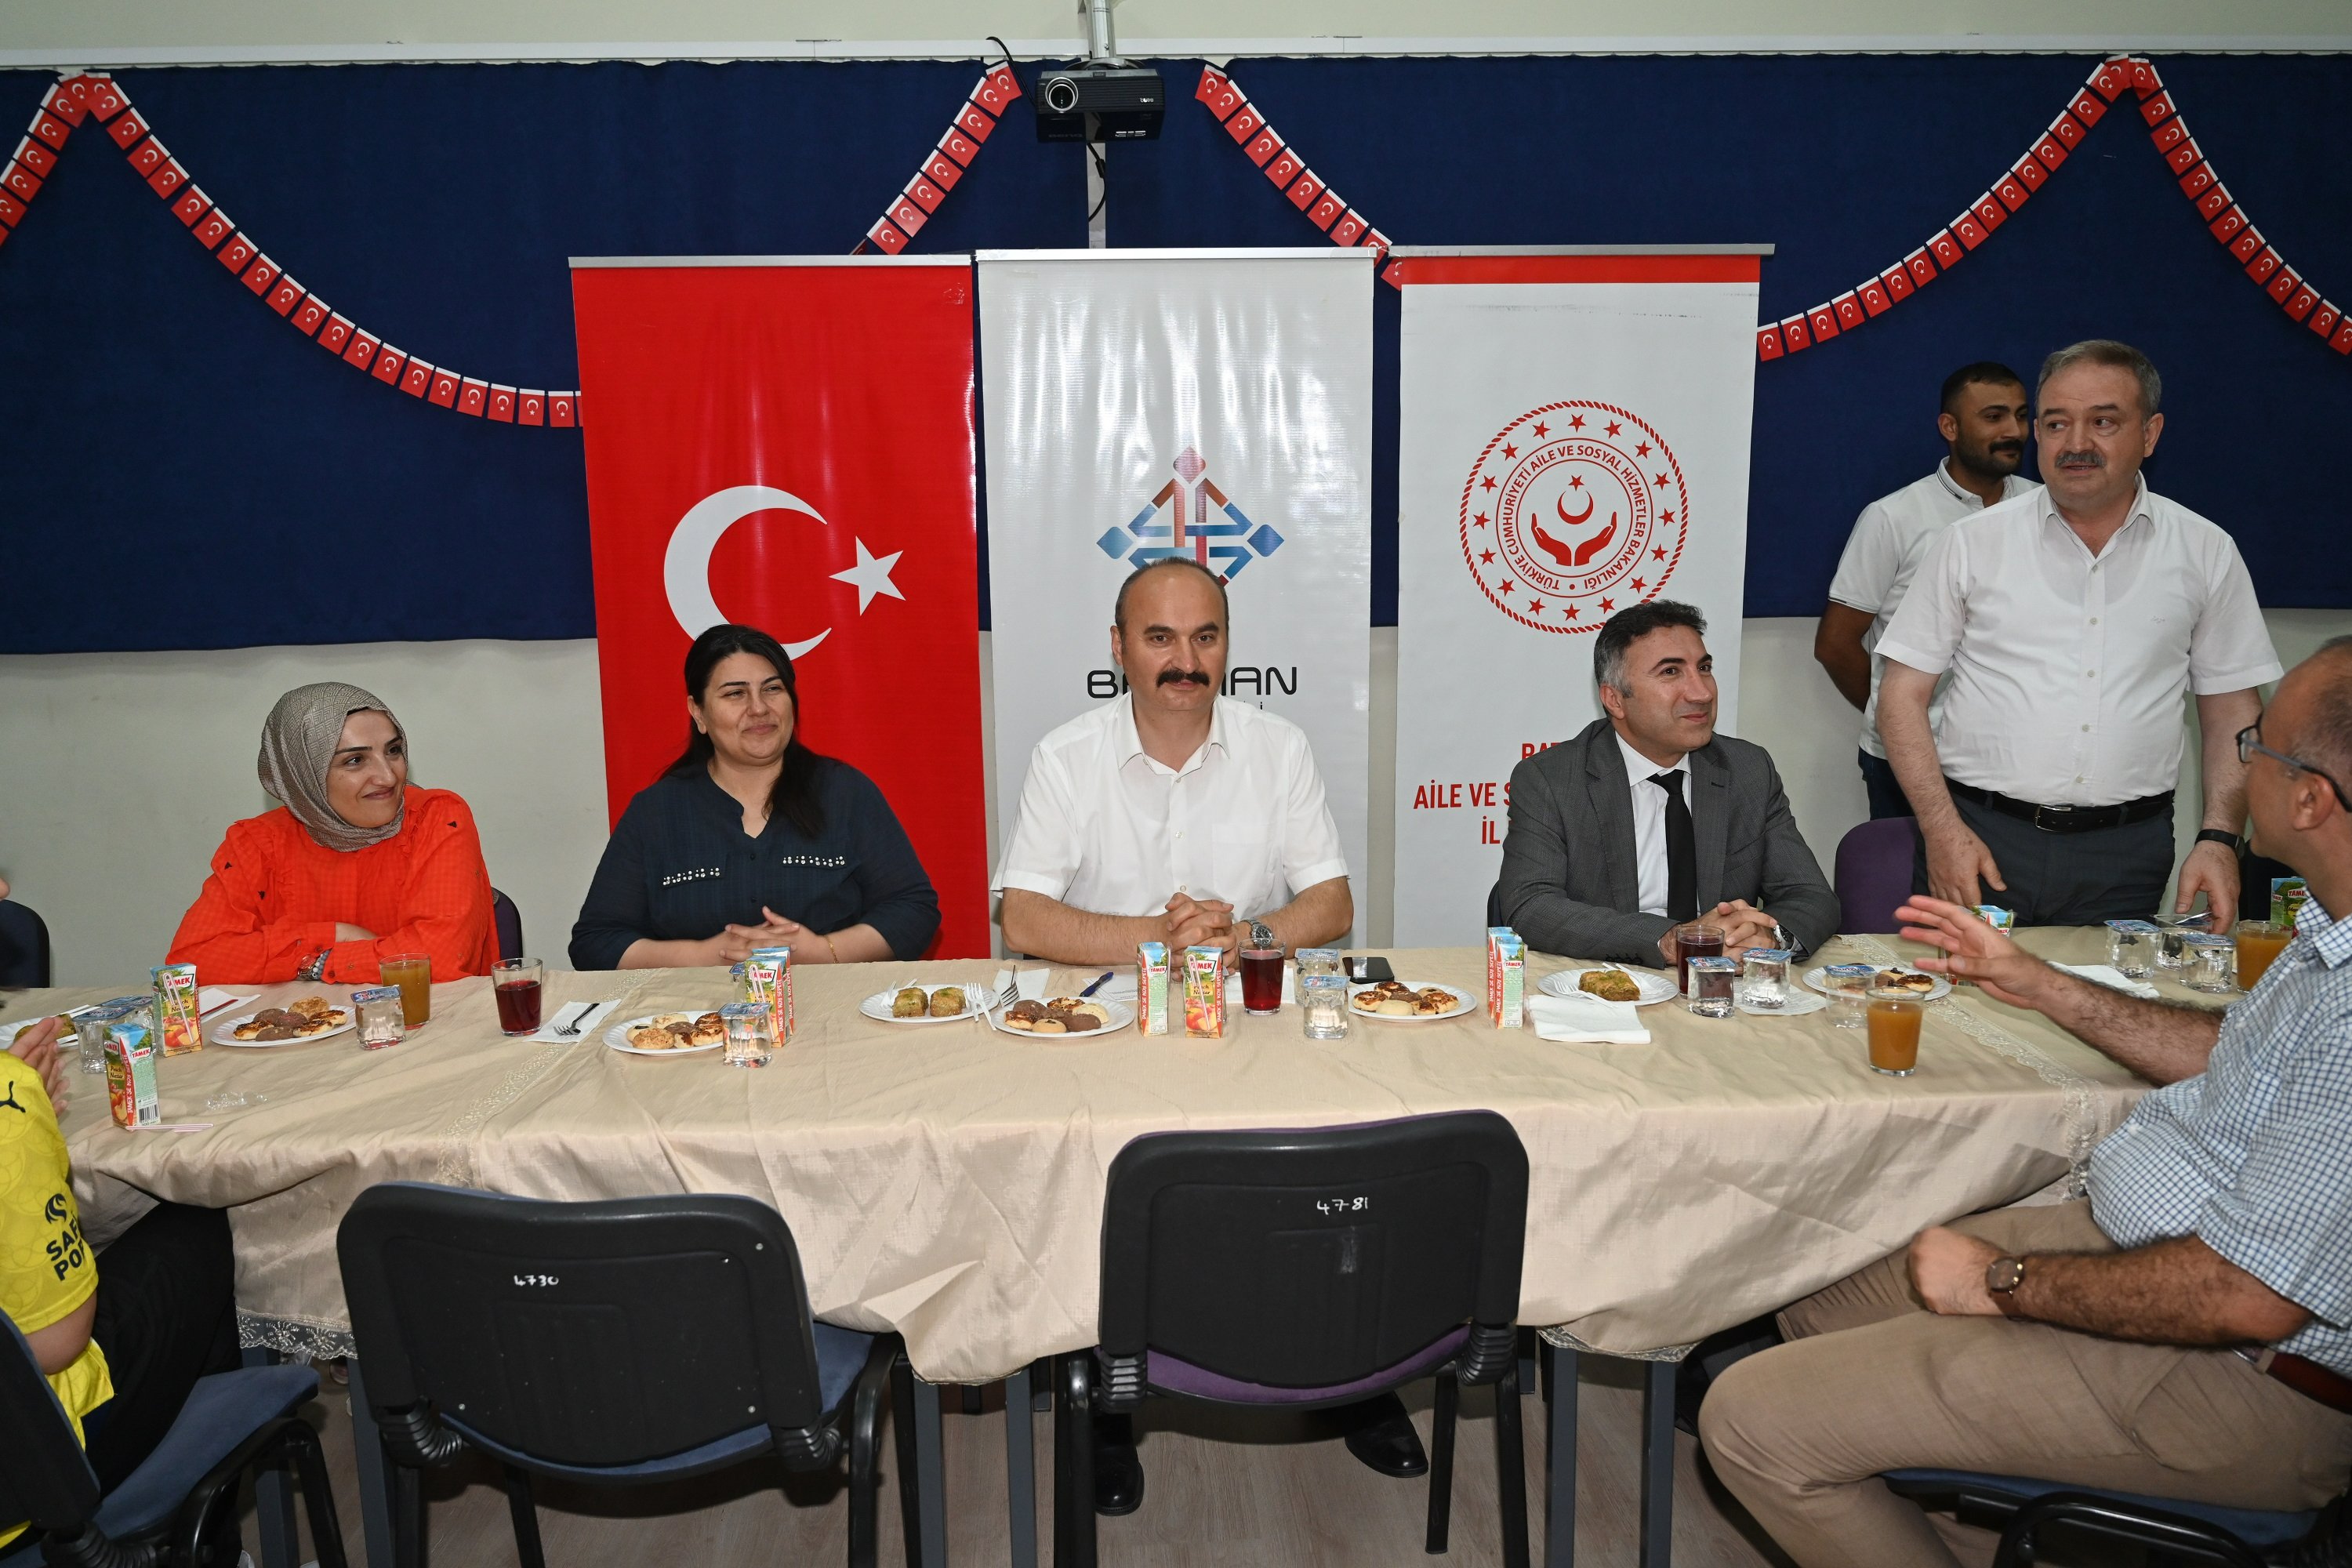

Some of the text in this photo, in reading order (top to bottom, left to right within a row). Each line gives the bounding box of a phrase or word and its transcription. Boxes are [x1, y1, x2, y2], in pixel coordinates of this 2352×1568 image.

[1503, 445, 1646, 590] TÜRKİYE CUMHURİYETİ AİLE VE SOSYAL HİZMETLER BAKANLIĞI
[1414, 779, 1462, 809] AİLE
[1468, 782, 1497, 807] VE
[1482, 815, 1501, 844] İL
[132, 1048, 151, 1058] TAMEK
[1316, 1196, 1368, 1215] 4781
[514, 1275, 559, 1287] 4730
